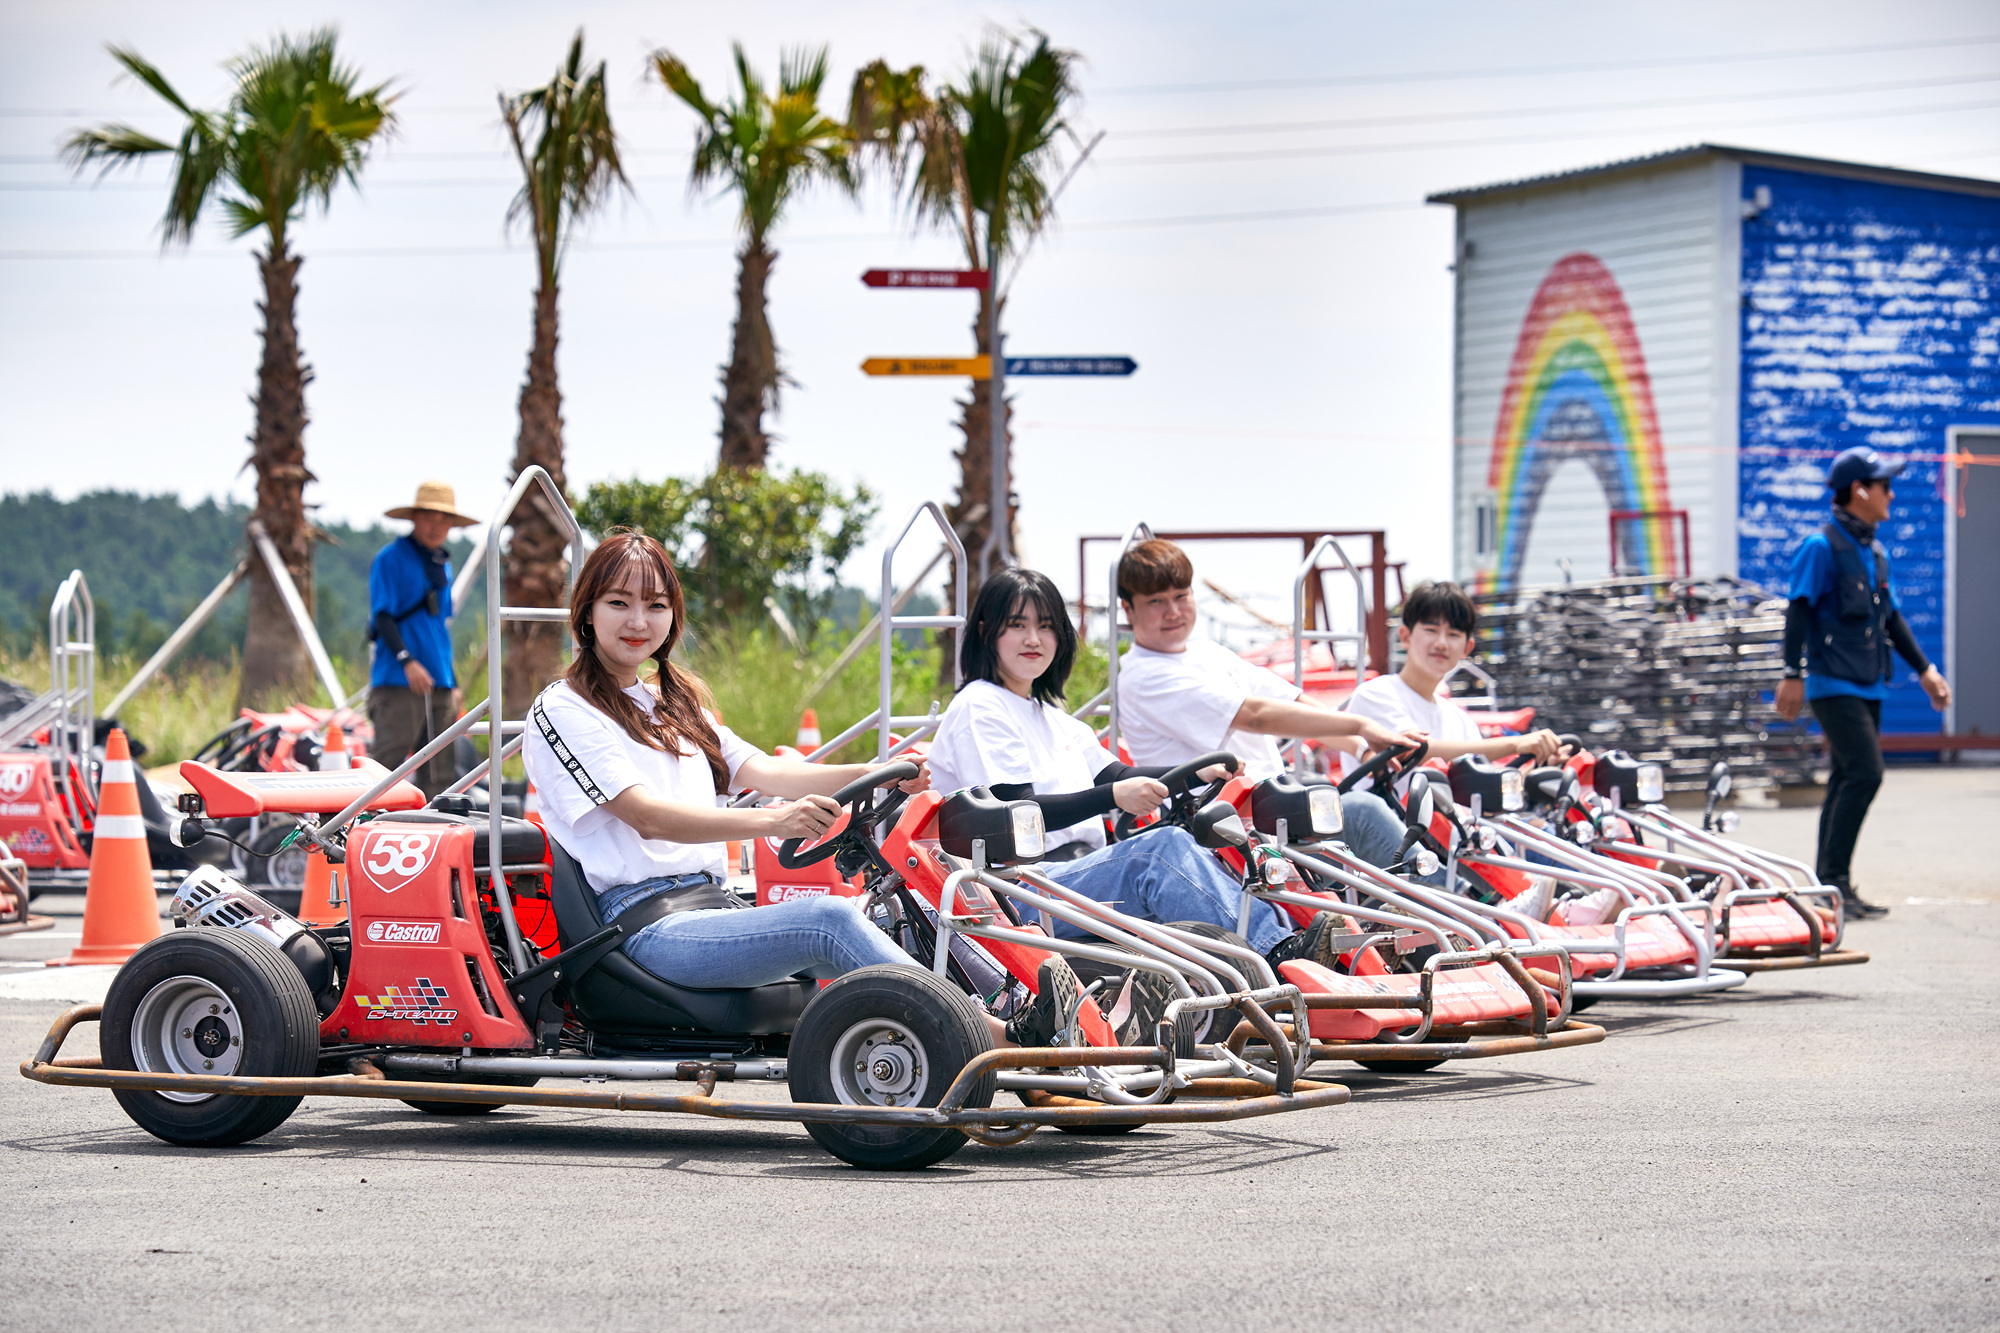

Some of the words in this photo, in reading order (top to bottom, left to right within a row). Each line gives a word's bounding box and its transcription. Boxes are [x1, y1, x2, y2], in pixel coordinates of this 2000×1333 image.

[536, 712, 552, 735] MARVEL
[553, 740, 572, 763] MARVEL
[573, 768, 593, 791] MARVEL
[368, 834, 431, 877] 58
[385, 923, 439, 941] Castrol
[366, 1008, 458, 1021] S-TEAM
